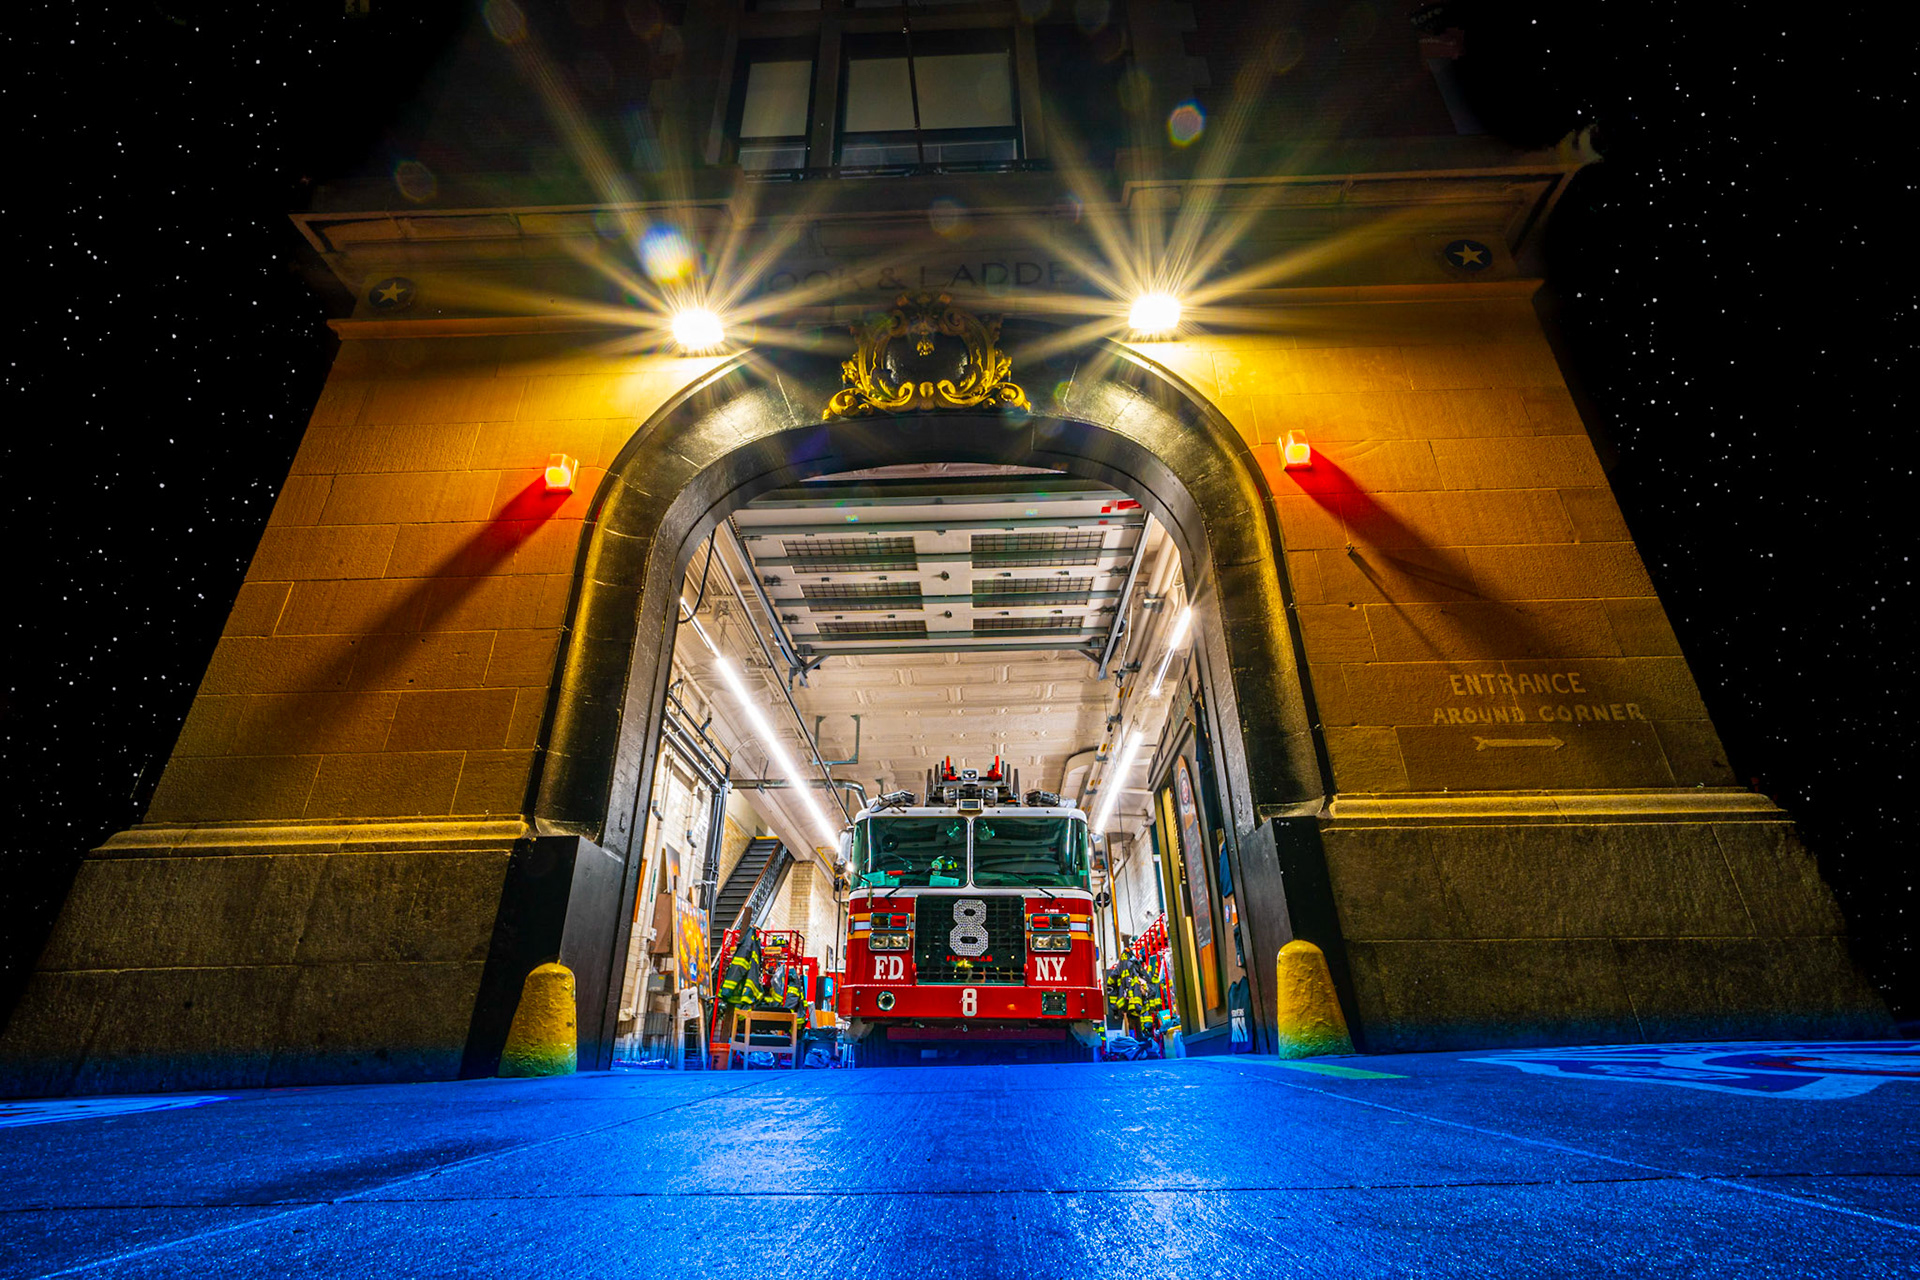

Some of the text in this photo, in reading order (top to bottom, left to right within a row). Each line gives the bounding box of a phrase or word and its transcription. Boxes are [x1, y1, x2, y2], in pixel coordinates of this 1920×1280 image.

[877, 266, 908, 291] &
[1450, 672, 1587, 696] ENTRANCE
[1433, 702, 1647, 725] AROUND CORNER
[949, 898, 989, 956] 8
[873, 955, 905, 980] F.D.
[1035, 956, 1068, 982] N.Y.
[962, 988, 978, 1017] 8
